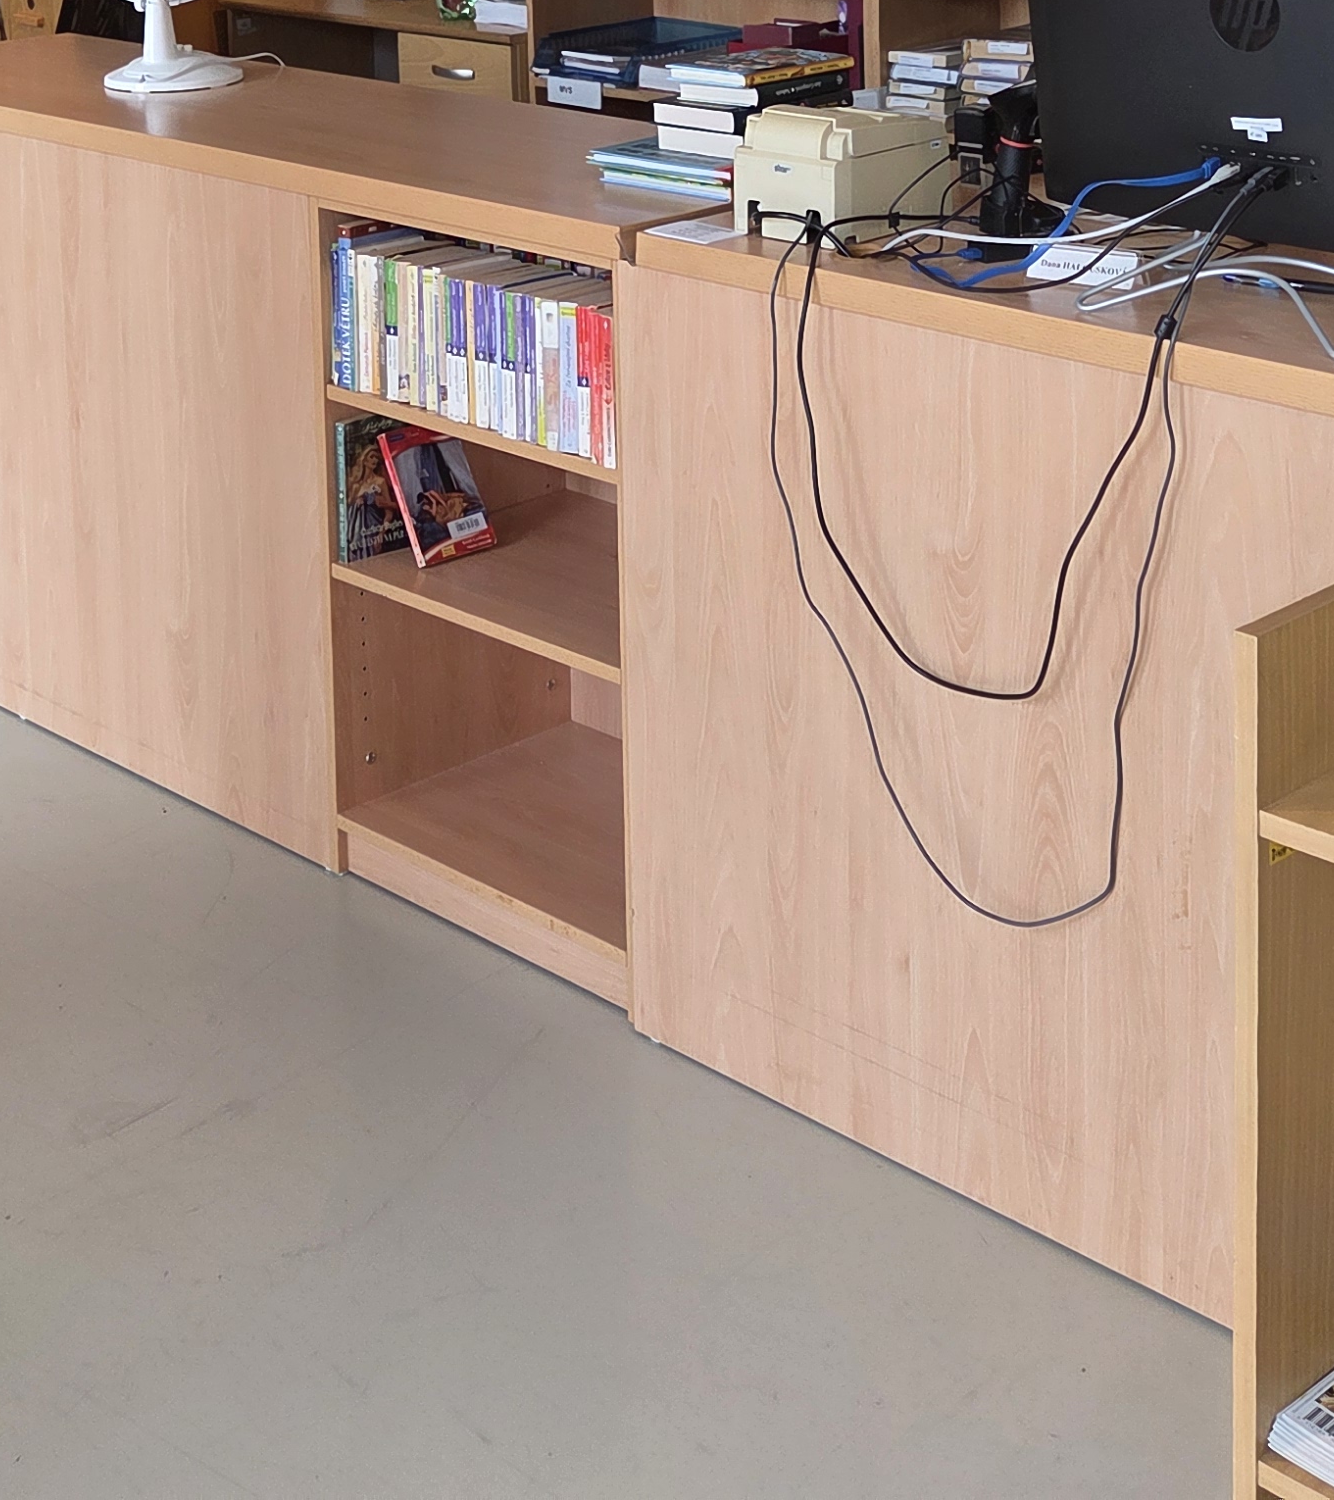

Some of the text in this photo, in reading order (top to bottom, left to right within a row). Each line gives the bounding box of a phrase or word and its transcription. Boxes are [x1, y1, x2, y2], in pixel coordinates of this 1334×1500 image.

[1041, 259, 1061, 268] Dana
[340, 297, 351, 385] DOTEK VĚTRU
